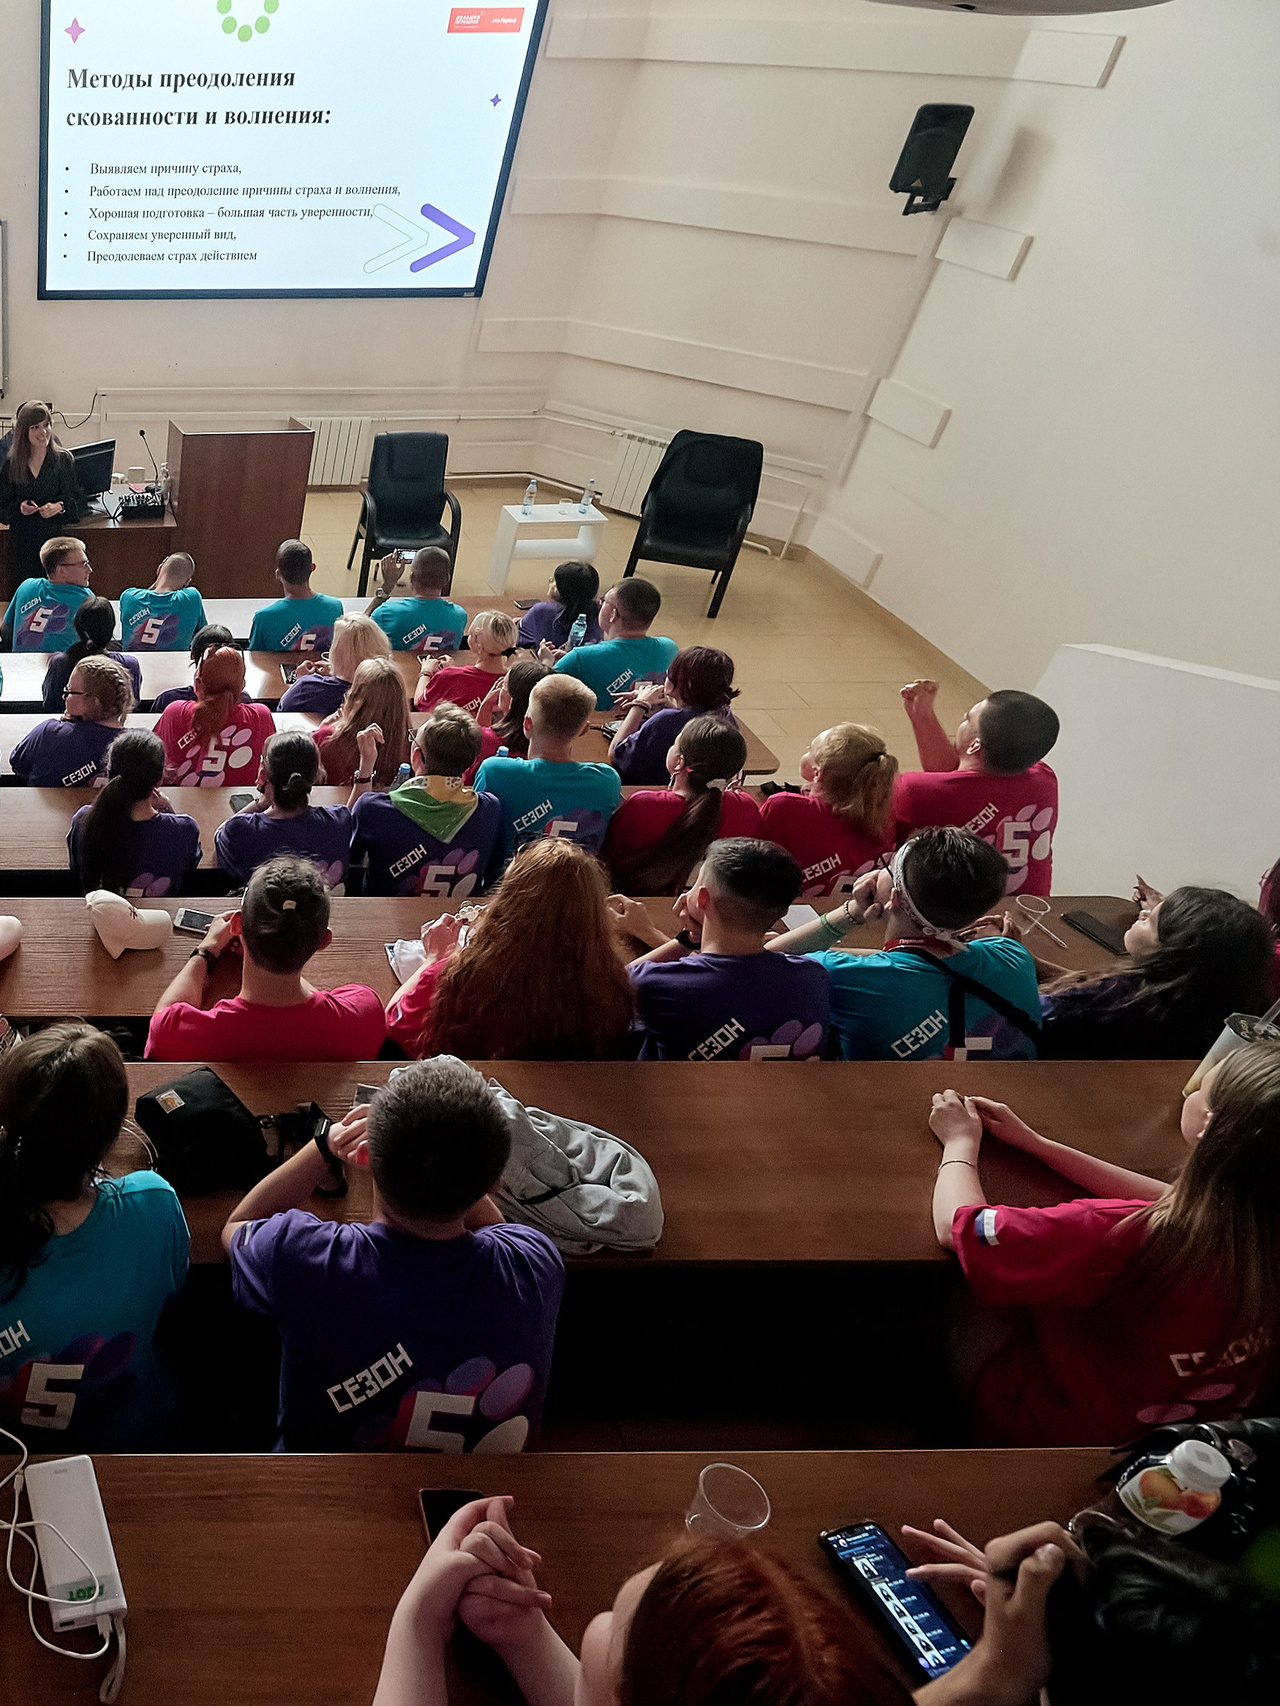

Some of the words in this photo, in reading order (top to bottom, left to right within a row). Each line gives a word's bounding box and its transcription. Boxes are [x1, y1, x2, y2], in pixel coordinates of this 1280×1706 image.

[66, 68, 153, 91] Методы
[159, 72, 296, 93] преодоления
[66, 111, 198, 126] скованности
[205, 111, 218, 125] и
[224, 109, 331, 125] волнения:
[90, 162, 147, 175] Выявляем
[150, 164, 199, 177] причину
[202, 164, 242, 176] страха,
[89, 185, 141, 197] Работаем
[144, 187, 165, 198] над
[167, 187, 239, 199] преодоление
[241, 186, 292, 199] причины
[295, 186, 332, 198] страха
[334, 186, 343, 195] и
[345, 185, 401, 196] волнения,
[88, 207, 139, 221] Хорошая
[142, 209, 205, 219] подготовка
[217, 206, 265, 218] большая
[268, 208, 298, 218] часть
[300, 207, 374, 220] уверенности,
[87, 229, 148, 243] Сохраняем
[150, 229, 211, 243] уверенный
[213, 230, 237, 241] вид,
[86, 250, 165, 264] Преодолеваем
[167, 252, 197, 264] страх
[200, 250, 258, 262] действием
[29, 607, 53, 633] 5
[141, 618, 165, 645] 5
[280, 623, 302, 647] СЕЗОН
[402, 624, 427, 644] СЕЗОН
[606, 668, 634, 694] СЕЗОН
[202, 737, 231, 773] 5
[62, 760, 97, 787] СЕЗОН
[513, 799, 553, 832] СЕЗОН
[959, 802, 1000, 835] ЕЗОН
[1002, 821, 1031, 868] 5
[388, 844, 427, 878] СЕЗОН
[802, 853, 842, 882] ЕЗОН
[421, 865, 456, 897] 5
[890, 1009, 948, 1059] СЕЗОН
[326, 1342, 413, 1414] СЕЗОН
[20, 1362, 85, 1430] 5
[404, 1390, 476, 1454] 5
